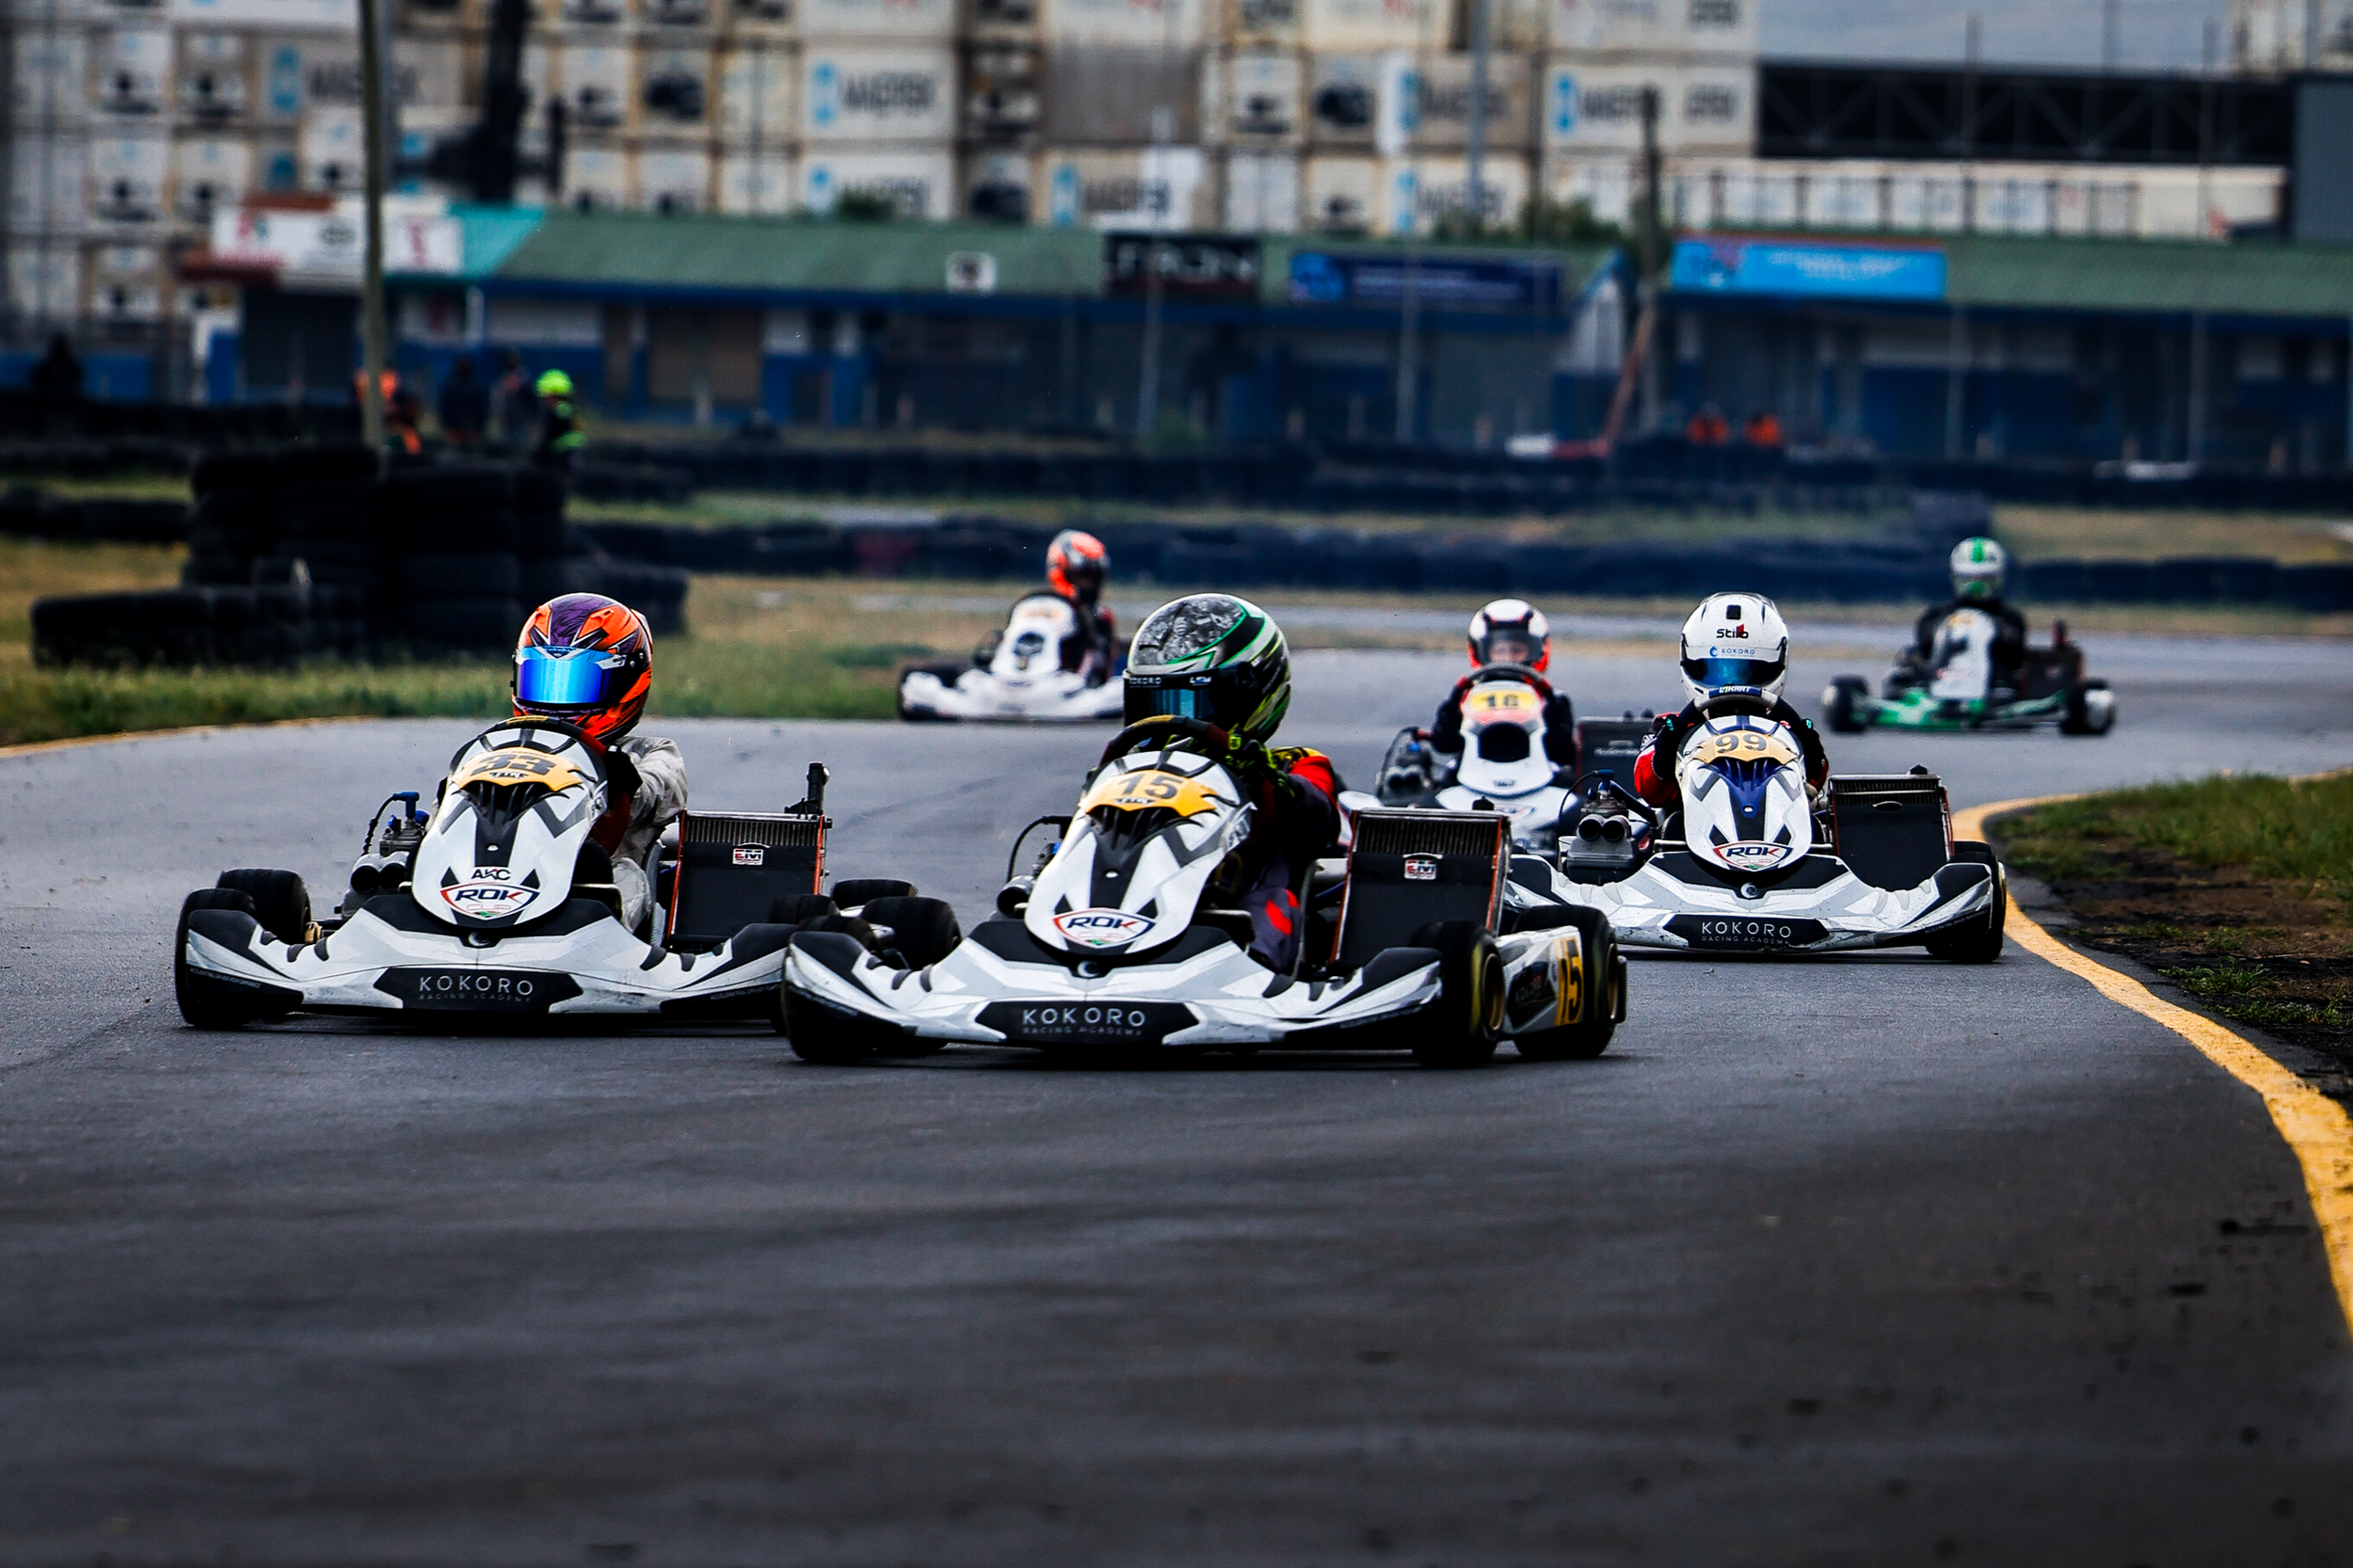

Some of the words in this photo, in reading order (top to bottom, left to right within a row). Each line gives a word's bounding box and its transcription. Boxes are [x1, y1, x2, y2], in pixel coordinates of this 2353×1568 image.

[1716, 623, 1749, 639] Stilo
[1715, 734, 1767, 754] 99
[470, 753, 556, 776] 33
[1117, 773, 1184, 800] 15
[1725, 846, 1781, 857] ROK
[471, 868, 512, 881] AKC
[454, 888, 524, 904] ROK
[1066, 916, 1140, 930] ROK
[1702, 921, 1792, 938] KOKORO
[1743, 936, 1789, 945] ACADEMY
[419, 975, 533, 996] KOKORO
[1561, 938, 1582, 1023] 15
[1022, 1007, 1145, 1027] KOKORO
[1022, 1026, 1072, 1034] RACING
[1078, 1025, 1142, 1035] ACADEMY
